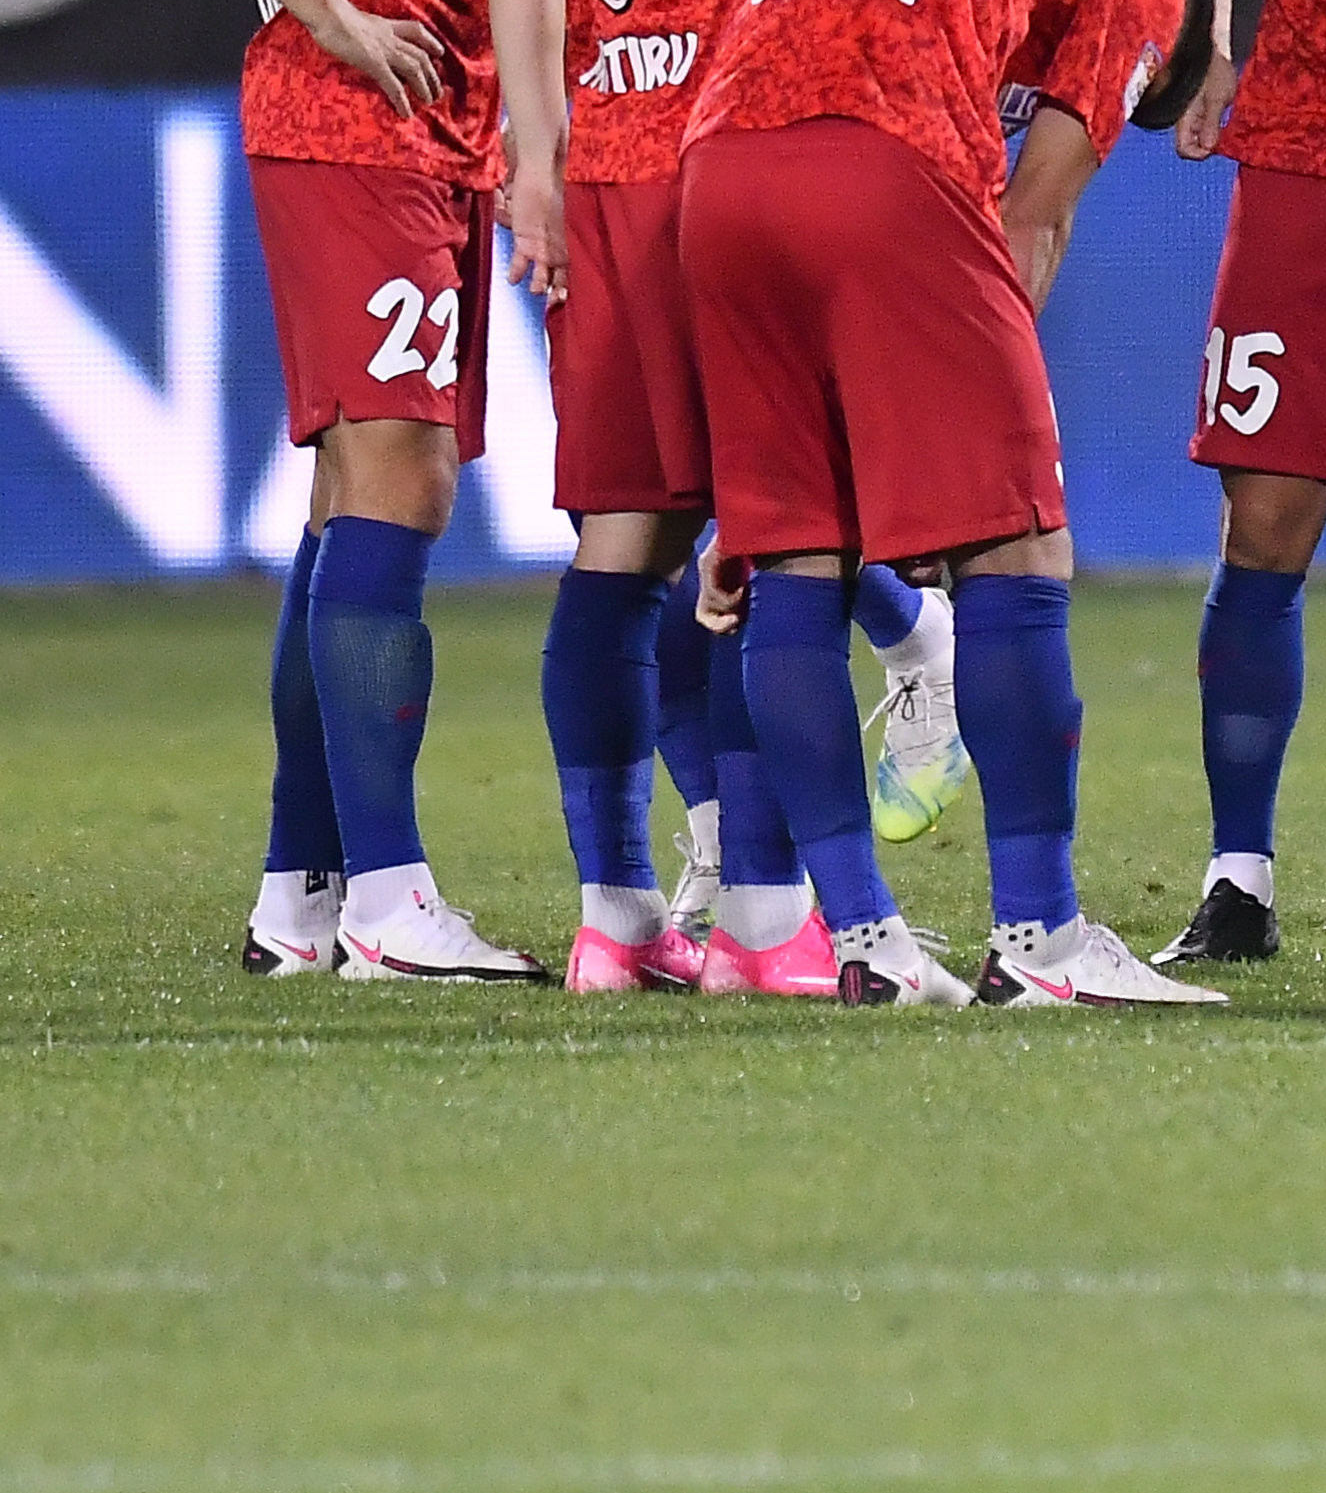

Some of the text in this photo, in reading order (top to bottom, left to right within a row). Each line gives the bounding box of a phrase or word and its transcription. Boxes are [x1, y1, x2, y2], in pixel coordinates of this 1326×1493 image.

[579, 32, 698, 94] TIRU
[366, 277, 459, 390] 22
[1204, 326, 1286, 436] 15
